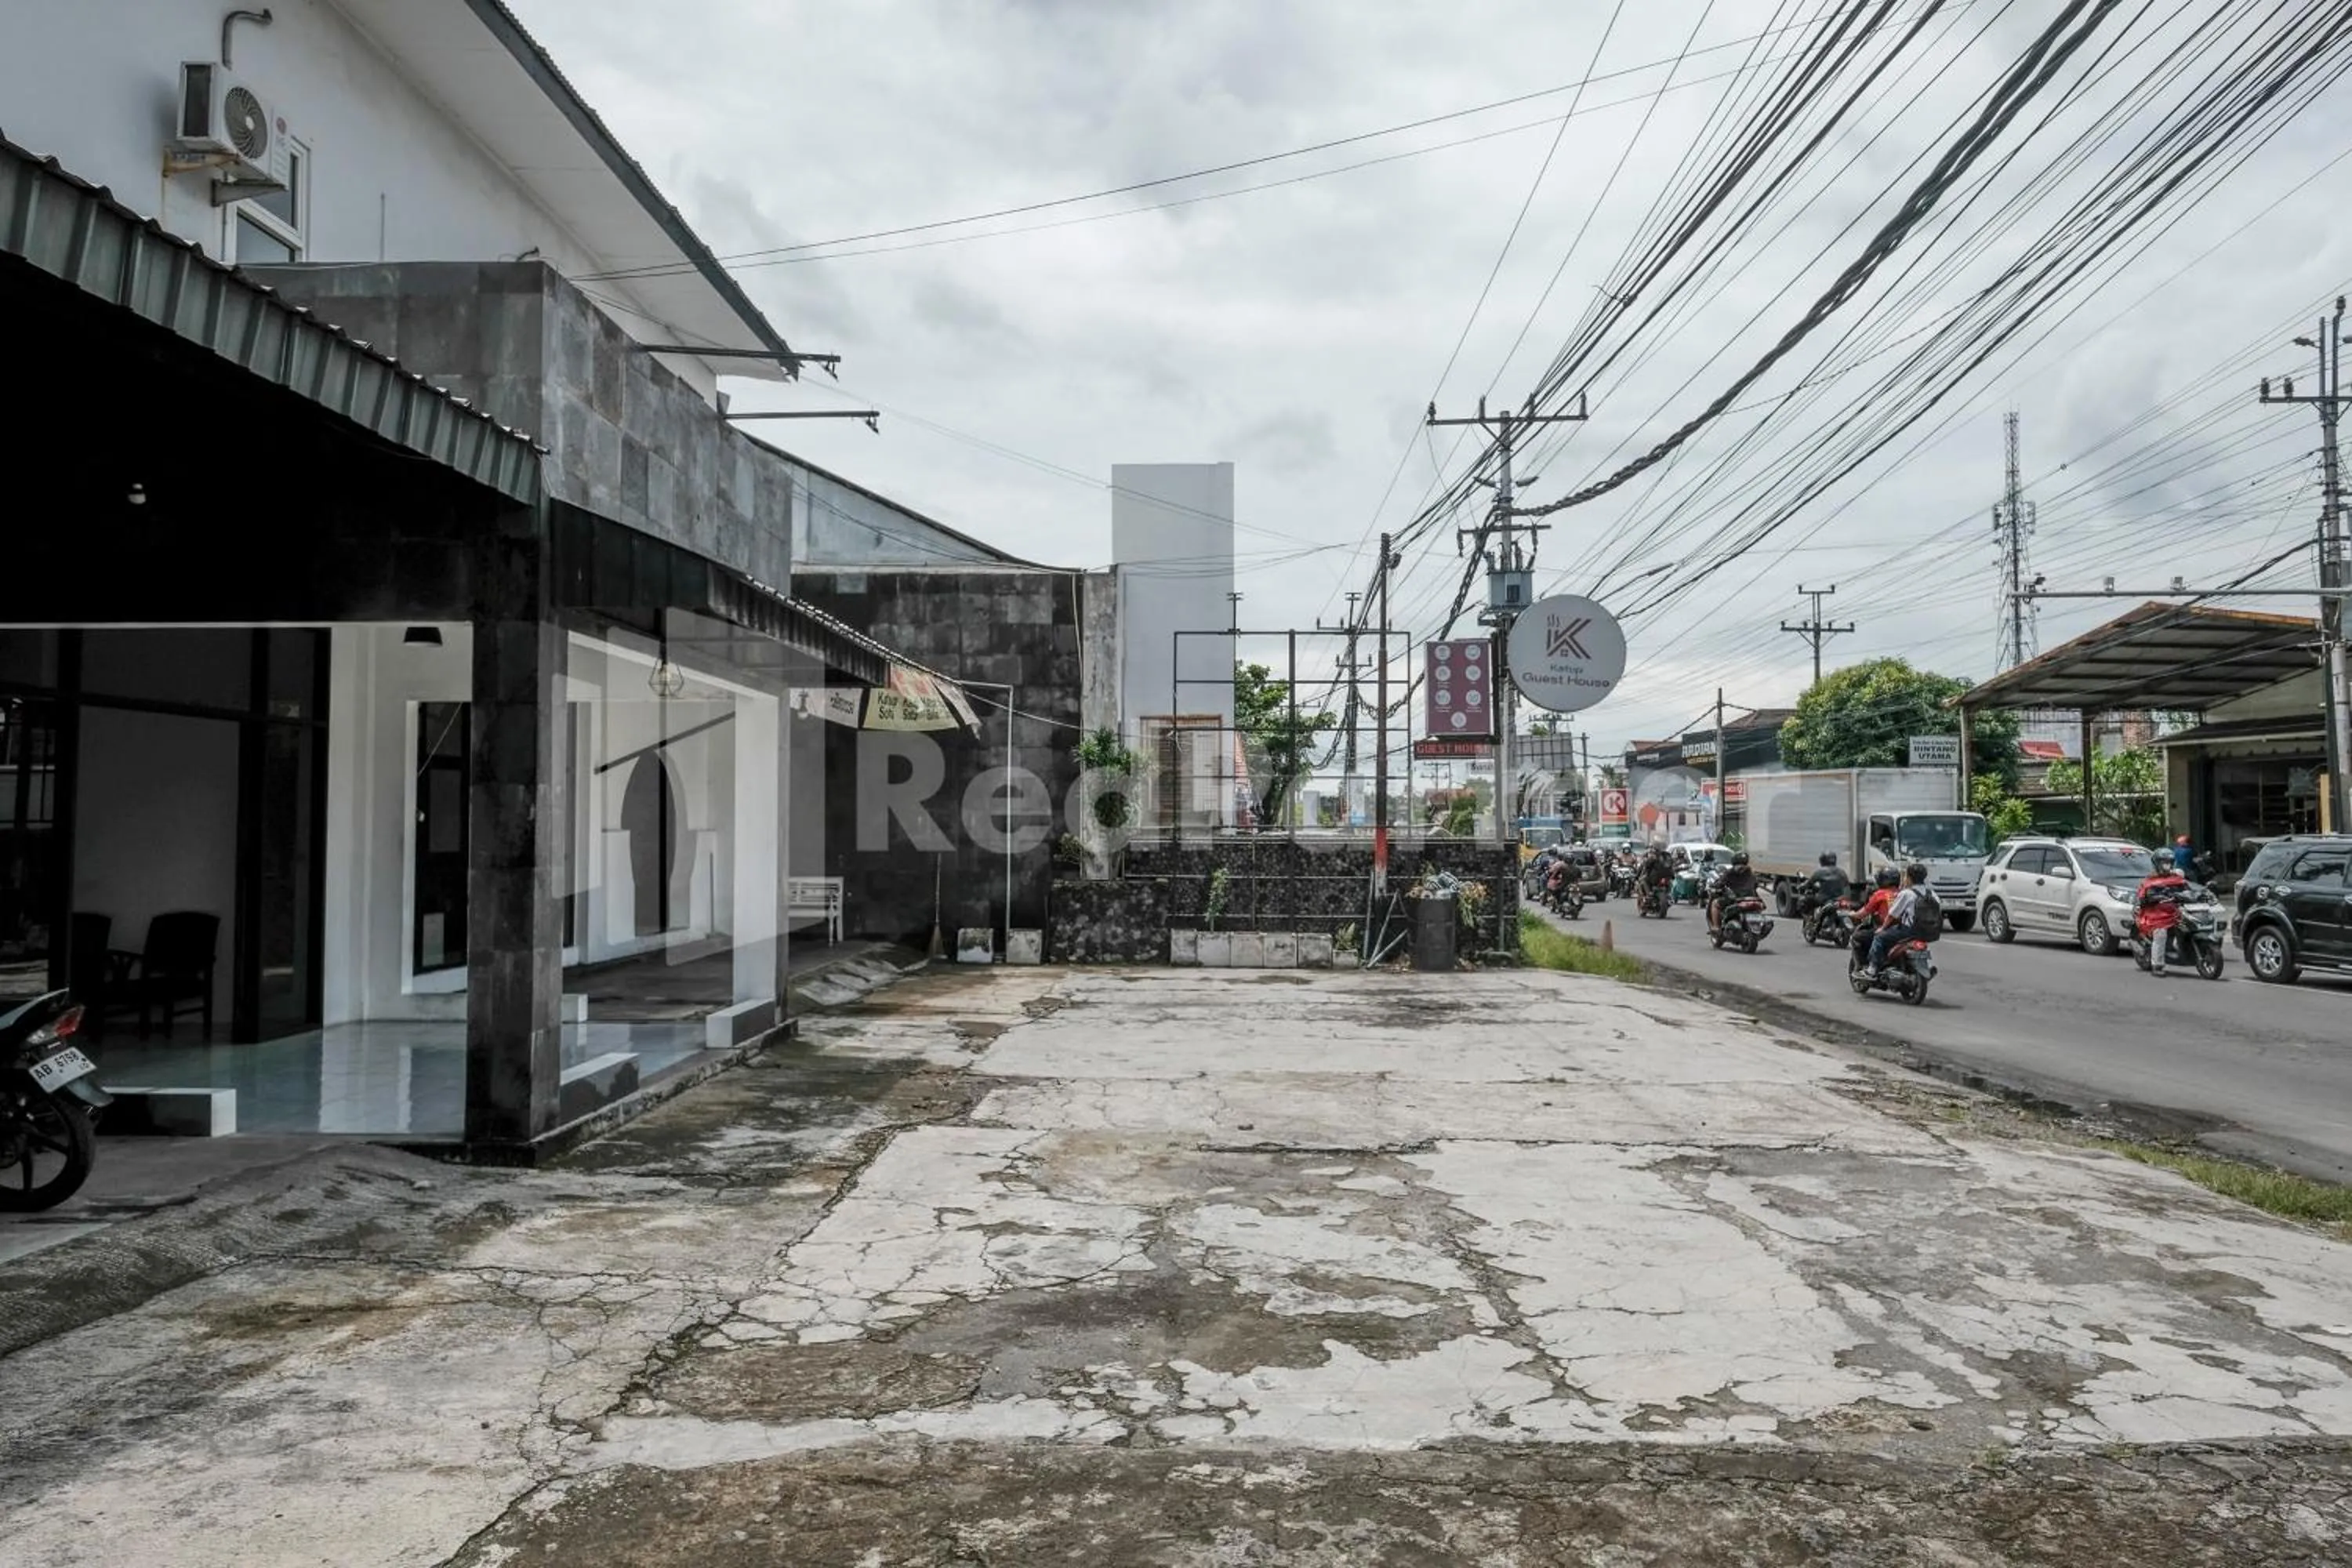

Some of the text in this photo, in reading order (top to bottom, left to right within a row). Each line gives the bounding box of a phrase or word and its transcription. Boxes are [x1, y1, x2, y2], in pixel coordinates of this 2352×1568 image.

[1522, 672, 1610, 688] Guest House
[34, 1064, 53, 1080] AB
